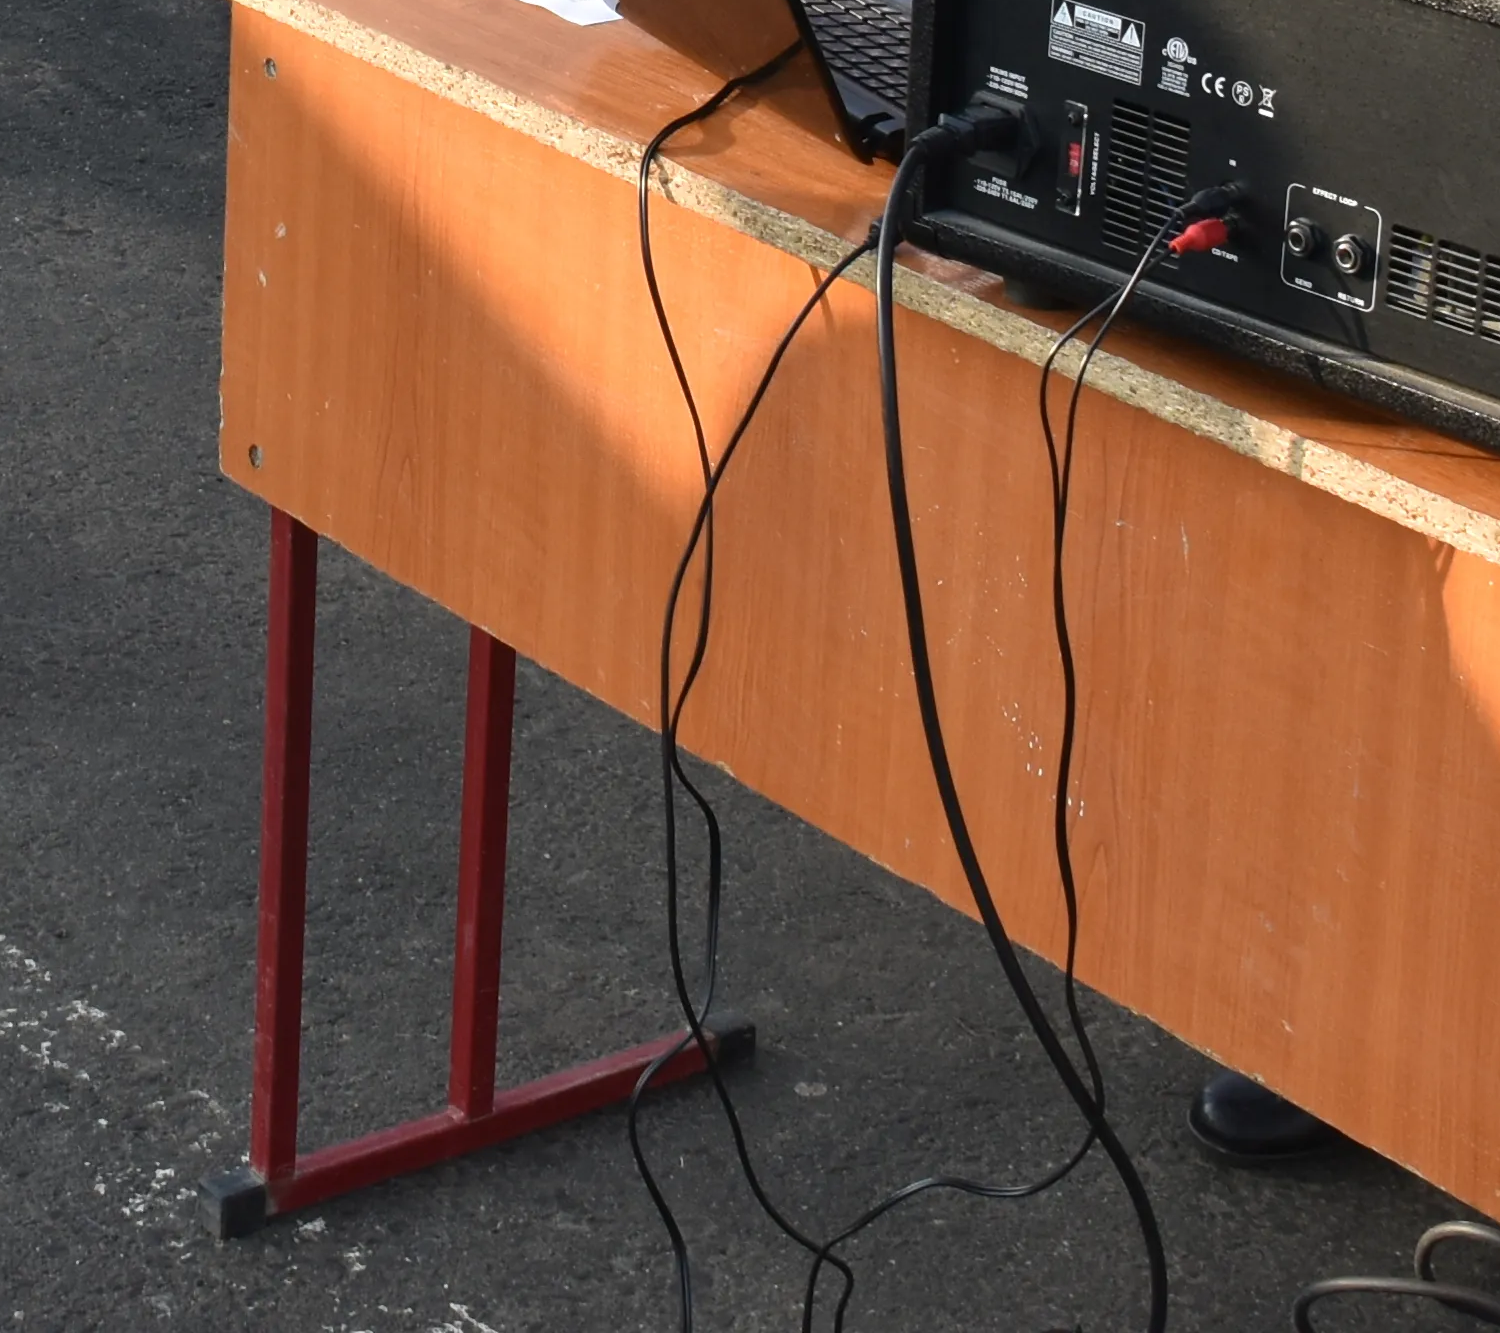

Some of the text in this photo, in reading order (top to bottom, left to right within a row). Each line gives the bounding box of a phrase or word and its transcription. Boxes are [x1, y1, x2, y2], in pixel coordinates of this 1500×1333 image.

[1312, 187, 1358, 207] EFFECT LOOP
[1337, 291, 1365, 307] RETURN
